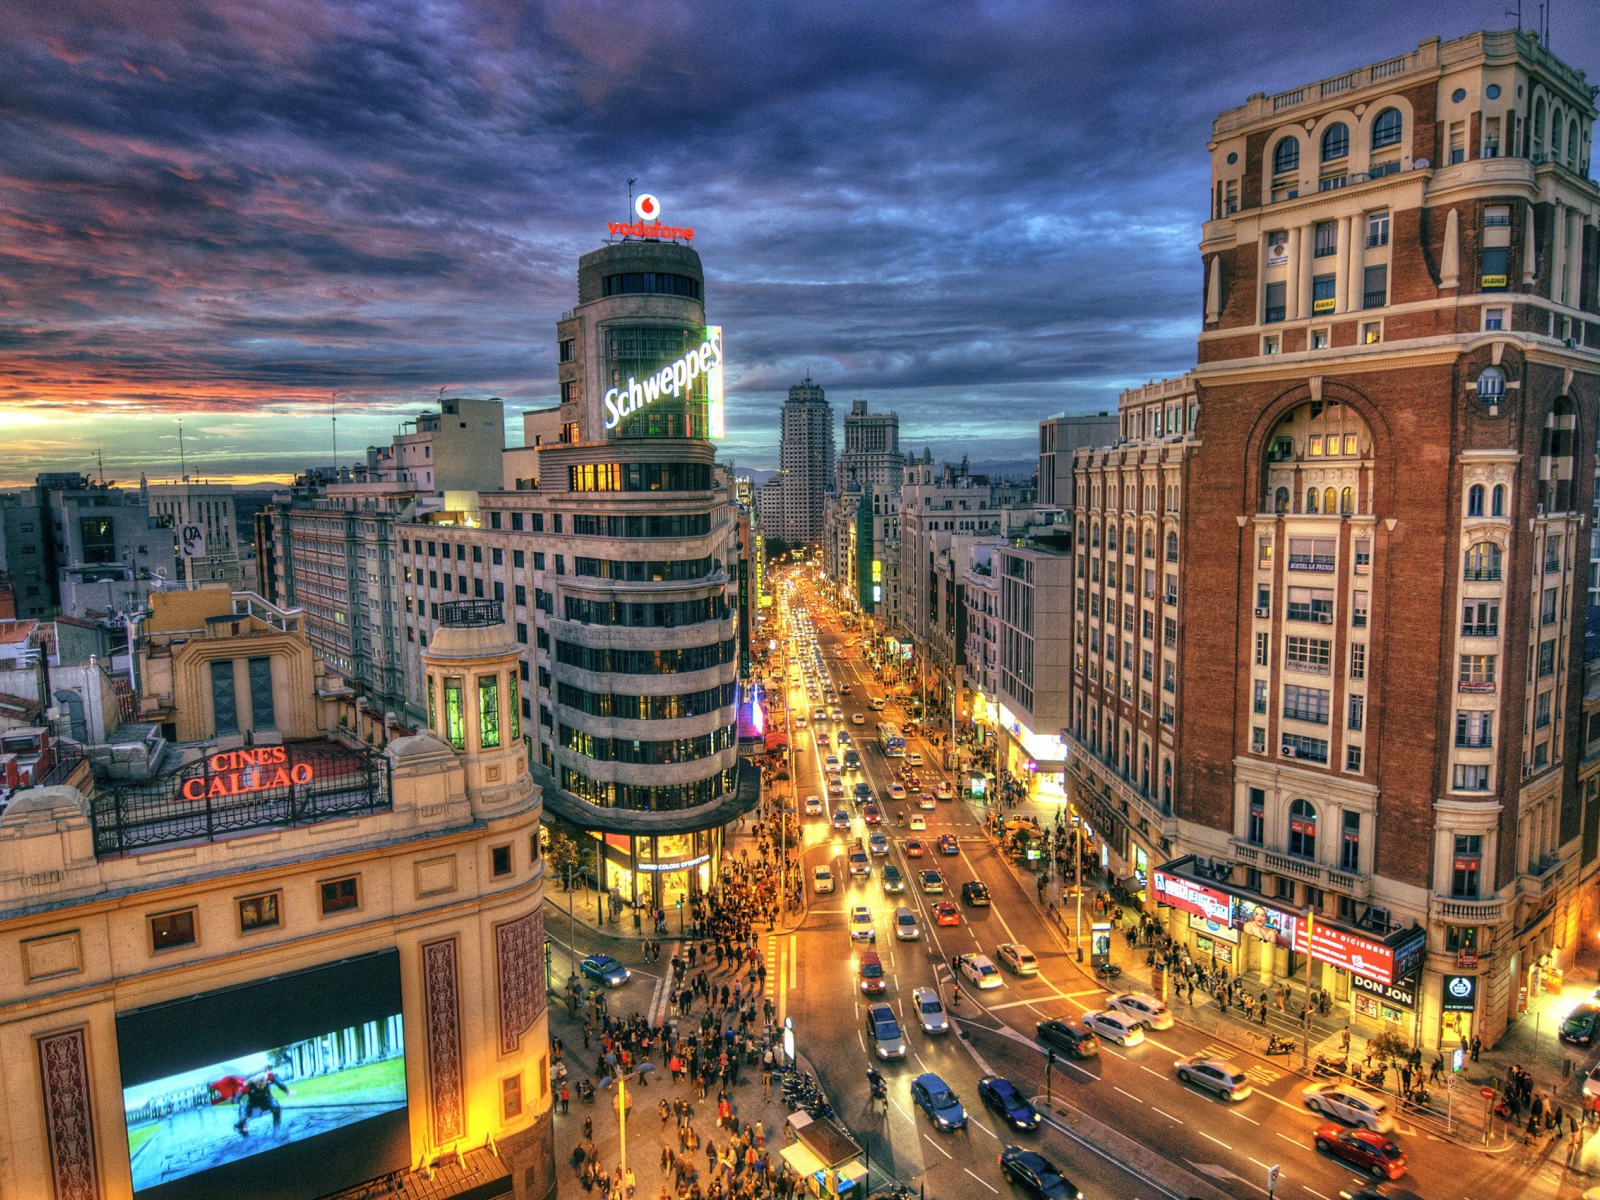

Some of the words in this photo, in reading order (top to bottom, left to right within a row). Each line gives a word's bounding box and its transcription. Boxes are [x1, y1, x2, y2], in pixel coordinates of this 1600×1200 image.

[607, 219, 695, 241] vodafone
[604, 334, 722, 430] Schweppes
[210, 746, 287, 772] CINES
[182, 763, 314, 801] CALLAO
[1325, 930, 1336, 938] DE
[1340, 935, 1391, 957] DICIEMBRE
[1354, 975, 1383, 994] DON
[1385, 987, 1412, 1004] JON
[1243, 1065, 1282, 1086] BUS
